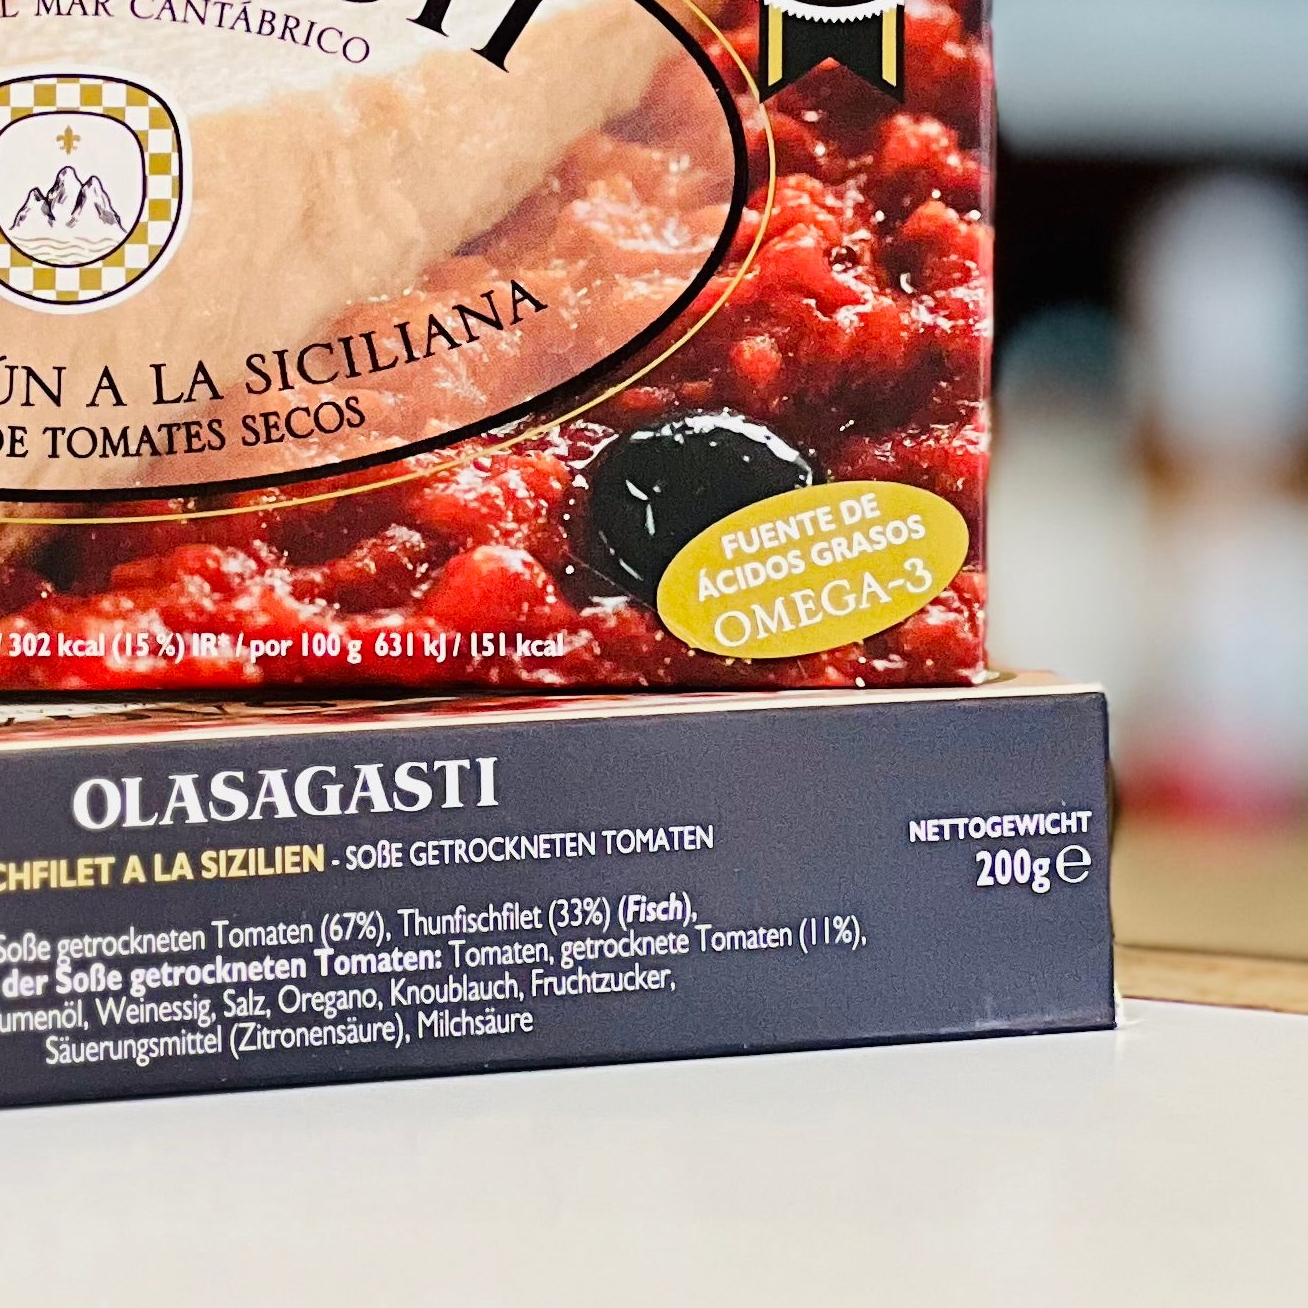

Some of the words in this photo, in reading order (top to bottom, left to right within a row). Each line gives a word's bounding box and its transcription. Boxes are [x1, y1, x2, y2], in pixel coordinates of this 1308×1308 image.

[85, 365, 127, 408] A
[149, 359, 224, 406] LA
[245, 278, 549, 395] SICILIANA
[41, 418, 226, 459] TOMATES
[241, 395, 367, 447] SECOS
[697, 548, 806, 602] ÁCIDOS
[810, 513, 927, 567] GRASOS
[720, 505, 837, 560] FUENTE
[839, 492, 882, 526] DE
[713, 557, 933, 648] OMEGA-3
[8, 632, 51, 658] 302
[57, 632, 106, 658] kcal
[236, 632, 245, 658] /
[249, 636, 292, 664] por
[301, 632, 341, 658] 100
[347, 638, 362, 665] g
[374, 632, 414, 658] 631
[424, 632, 446, 663] kJ
[453, 632, 461, 658] /
[470, 632, 506, 658] 151
[516, 632, 564, 658] kcal
[72, 757, 499, 830] OLASAGASTI
[908, 810, 1092, 843] NETTOGEWICHT
[122, 855, 147, 885] A
[154, 851, 194, 882] LA
[200, 843, 325, 880] SIZILIEN
[409, 832, 596, 867] GETROCKNETEN
[600, 824, 715, 855] TOMATEN
[975, 847, 1051, 894] 200g
[1, 969, 49, 998] der
[55, 962, 123, 994] Soße
[130, 955, 307, 997] getrockneten
[313, 946, 442, 977] Tomaten:
[447, 939, 554, 968] Tomaten,
[560, 928, 690, 969] getrocknete
[694, 923, 793, 952] Tomaten
[798, 915, 867, 954] (11%),
[56, 926, 206, 967] getrockneten
[211, 920, 314, 949] Tomaten
[320, 909, 392, 950] (67%),
[396, 901, 543, 936] Thunfischfilet
[548, 896, 611, 936] (33%)
[617, 891, 698, 931] (Fisch),
[95, 992, 217, 1028] Weinessig,
[223, 987, 272, 1019] Salz,
[277, 984, 383, 1019] Oregano,
[390, 971, 525, 1007] Knoublauch,
[530, 962, 676, 998] Fruchtzucker,
[45, 1024, 223, 1067] Säuerungsmittel
[229, 1012, 411, 1061] (Zitronensäure),
[417, 1007, 534, 1039] Milchsäure
